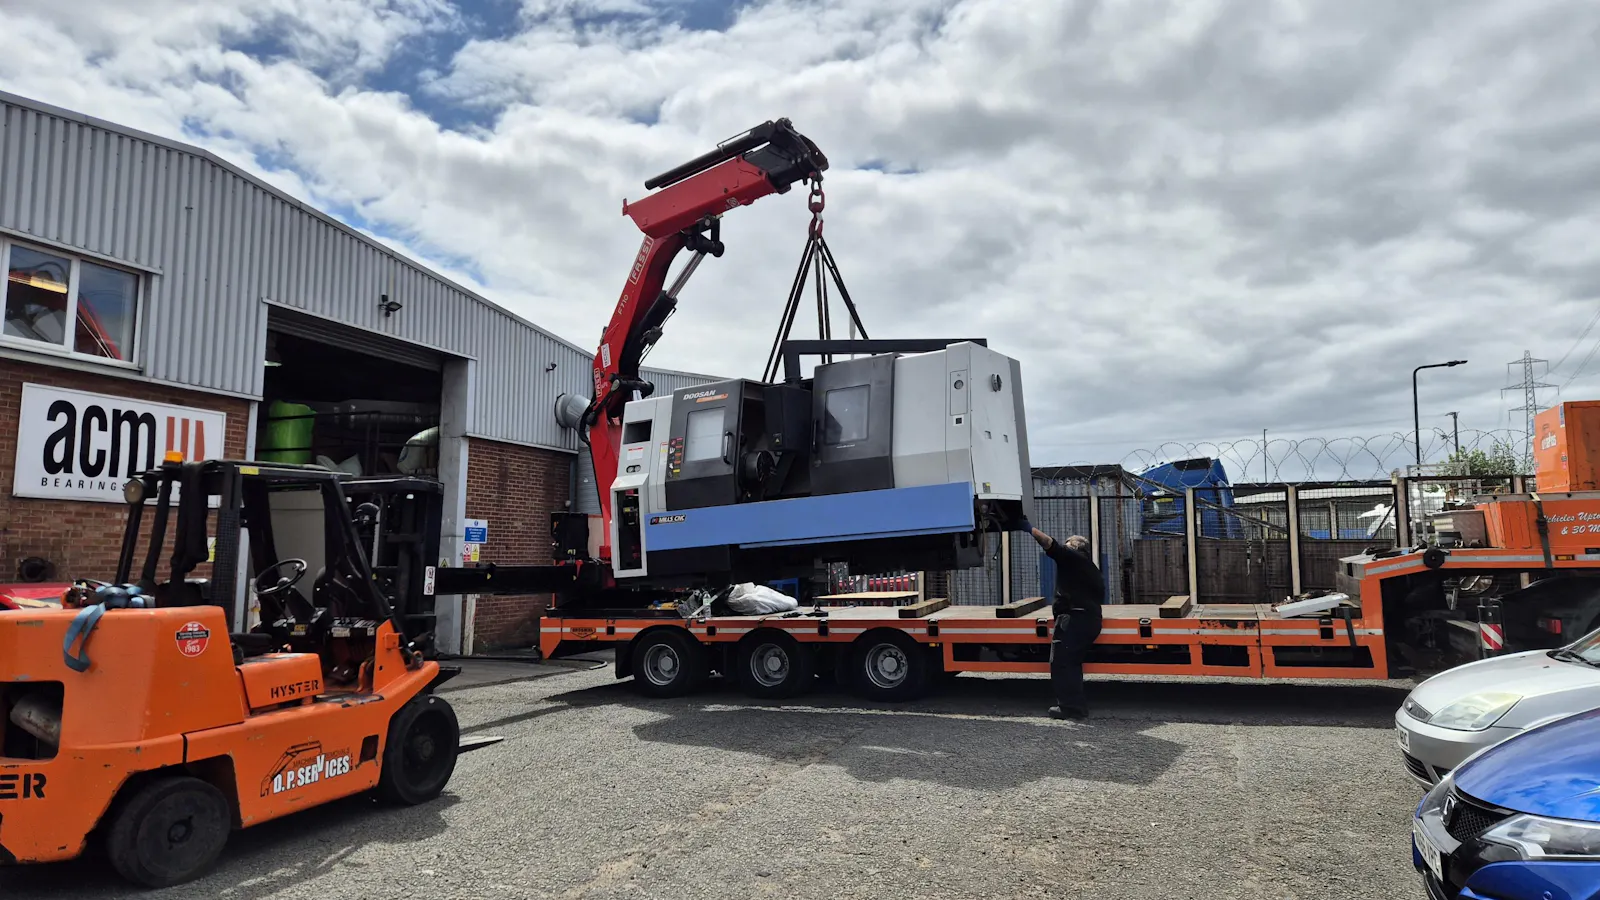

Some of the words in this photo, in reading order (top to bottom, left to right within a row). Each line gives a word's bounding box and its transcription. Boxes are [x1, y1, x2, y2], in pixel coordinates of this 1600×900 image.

[632, 240, 652, 280] FASSI
[683, 389, 717, 401] DOOSAN
[43, 400, 157, 478] acm
[1561, 526, 1569, 535] &
[1571, 525, 1586, 535] 30
[184, 644, 200, 653] 1983
[270, 679, 319, 699] HYSTER
[297, 754, 351, 787] SERVICES
[0, 773, 47, 799] ER
